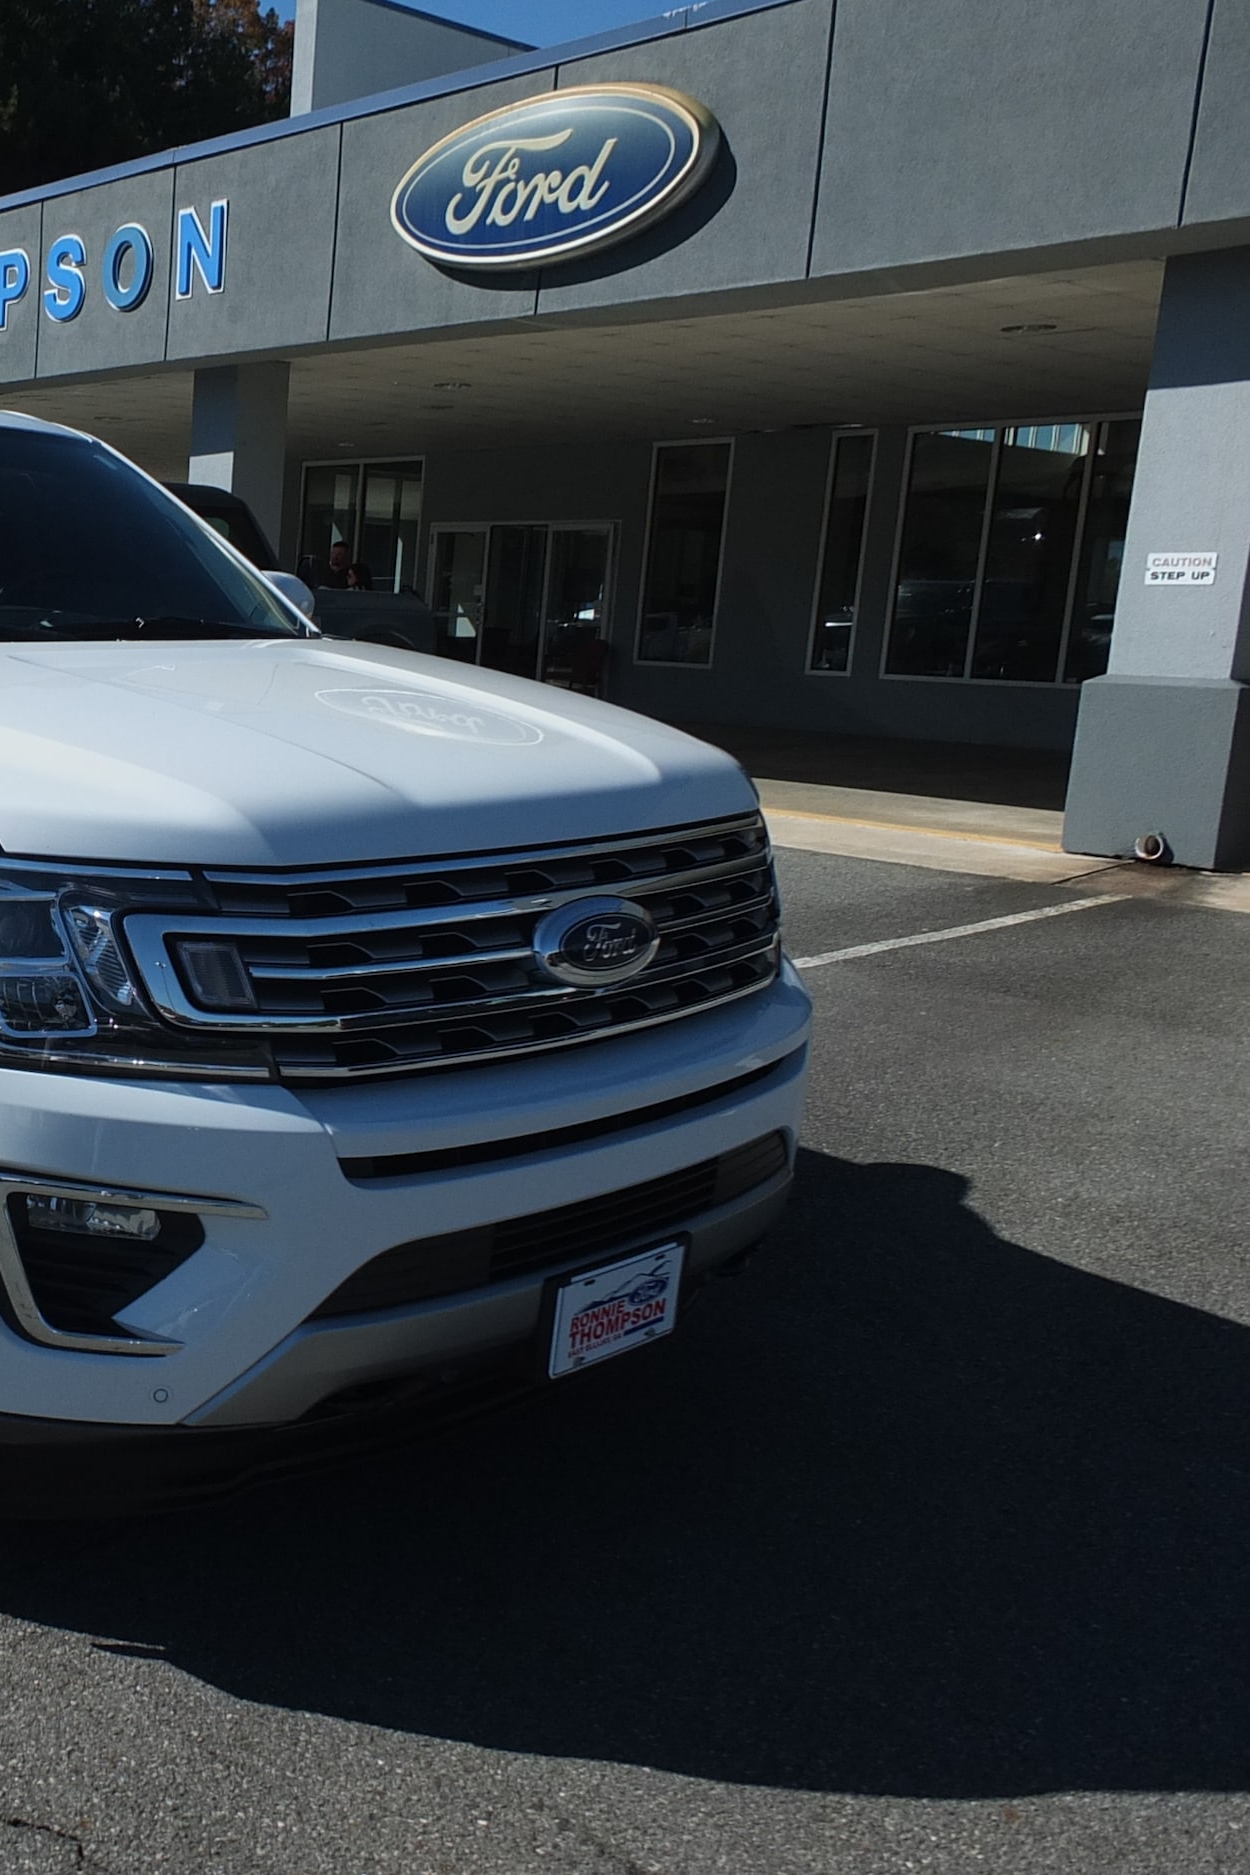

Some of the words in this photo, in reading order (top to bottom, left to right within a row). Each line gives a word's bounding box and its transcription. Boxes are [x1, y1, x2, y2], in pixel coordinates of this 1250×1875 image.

[445, 127, 619, 236] Ford
[1150, 571, 1185, 580] STEP
[1191, 571, 1210, 580] UP
[1152, 558, 1213, 567] CAUTION
[583, 922, 636, 962] Ford
[569, 1300, 625, 1333] RONNIE
[569, 1298, 667, 1349] THOMPSON
